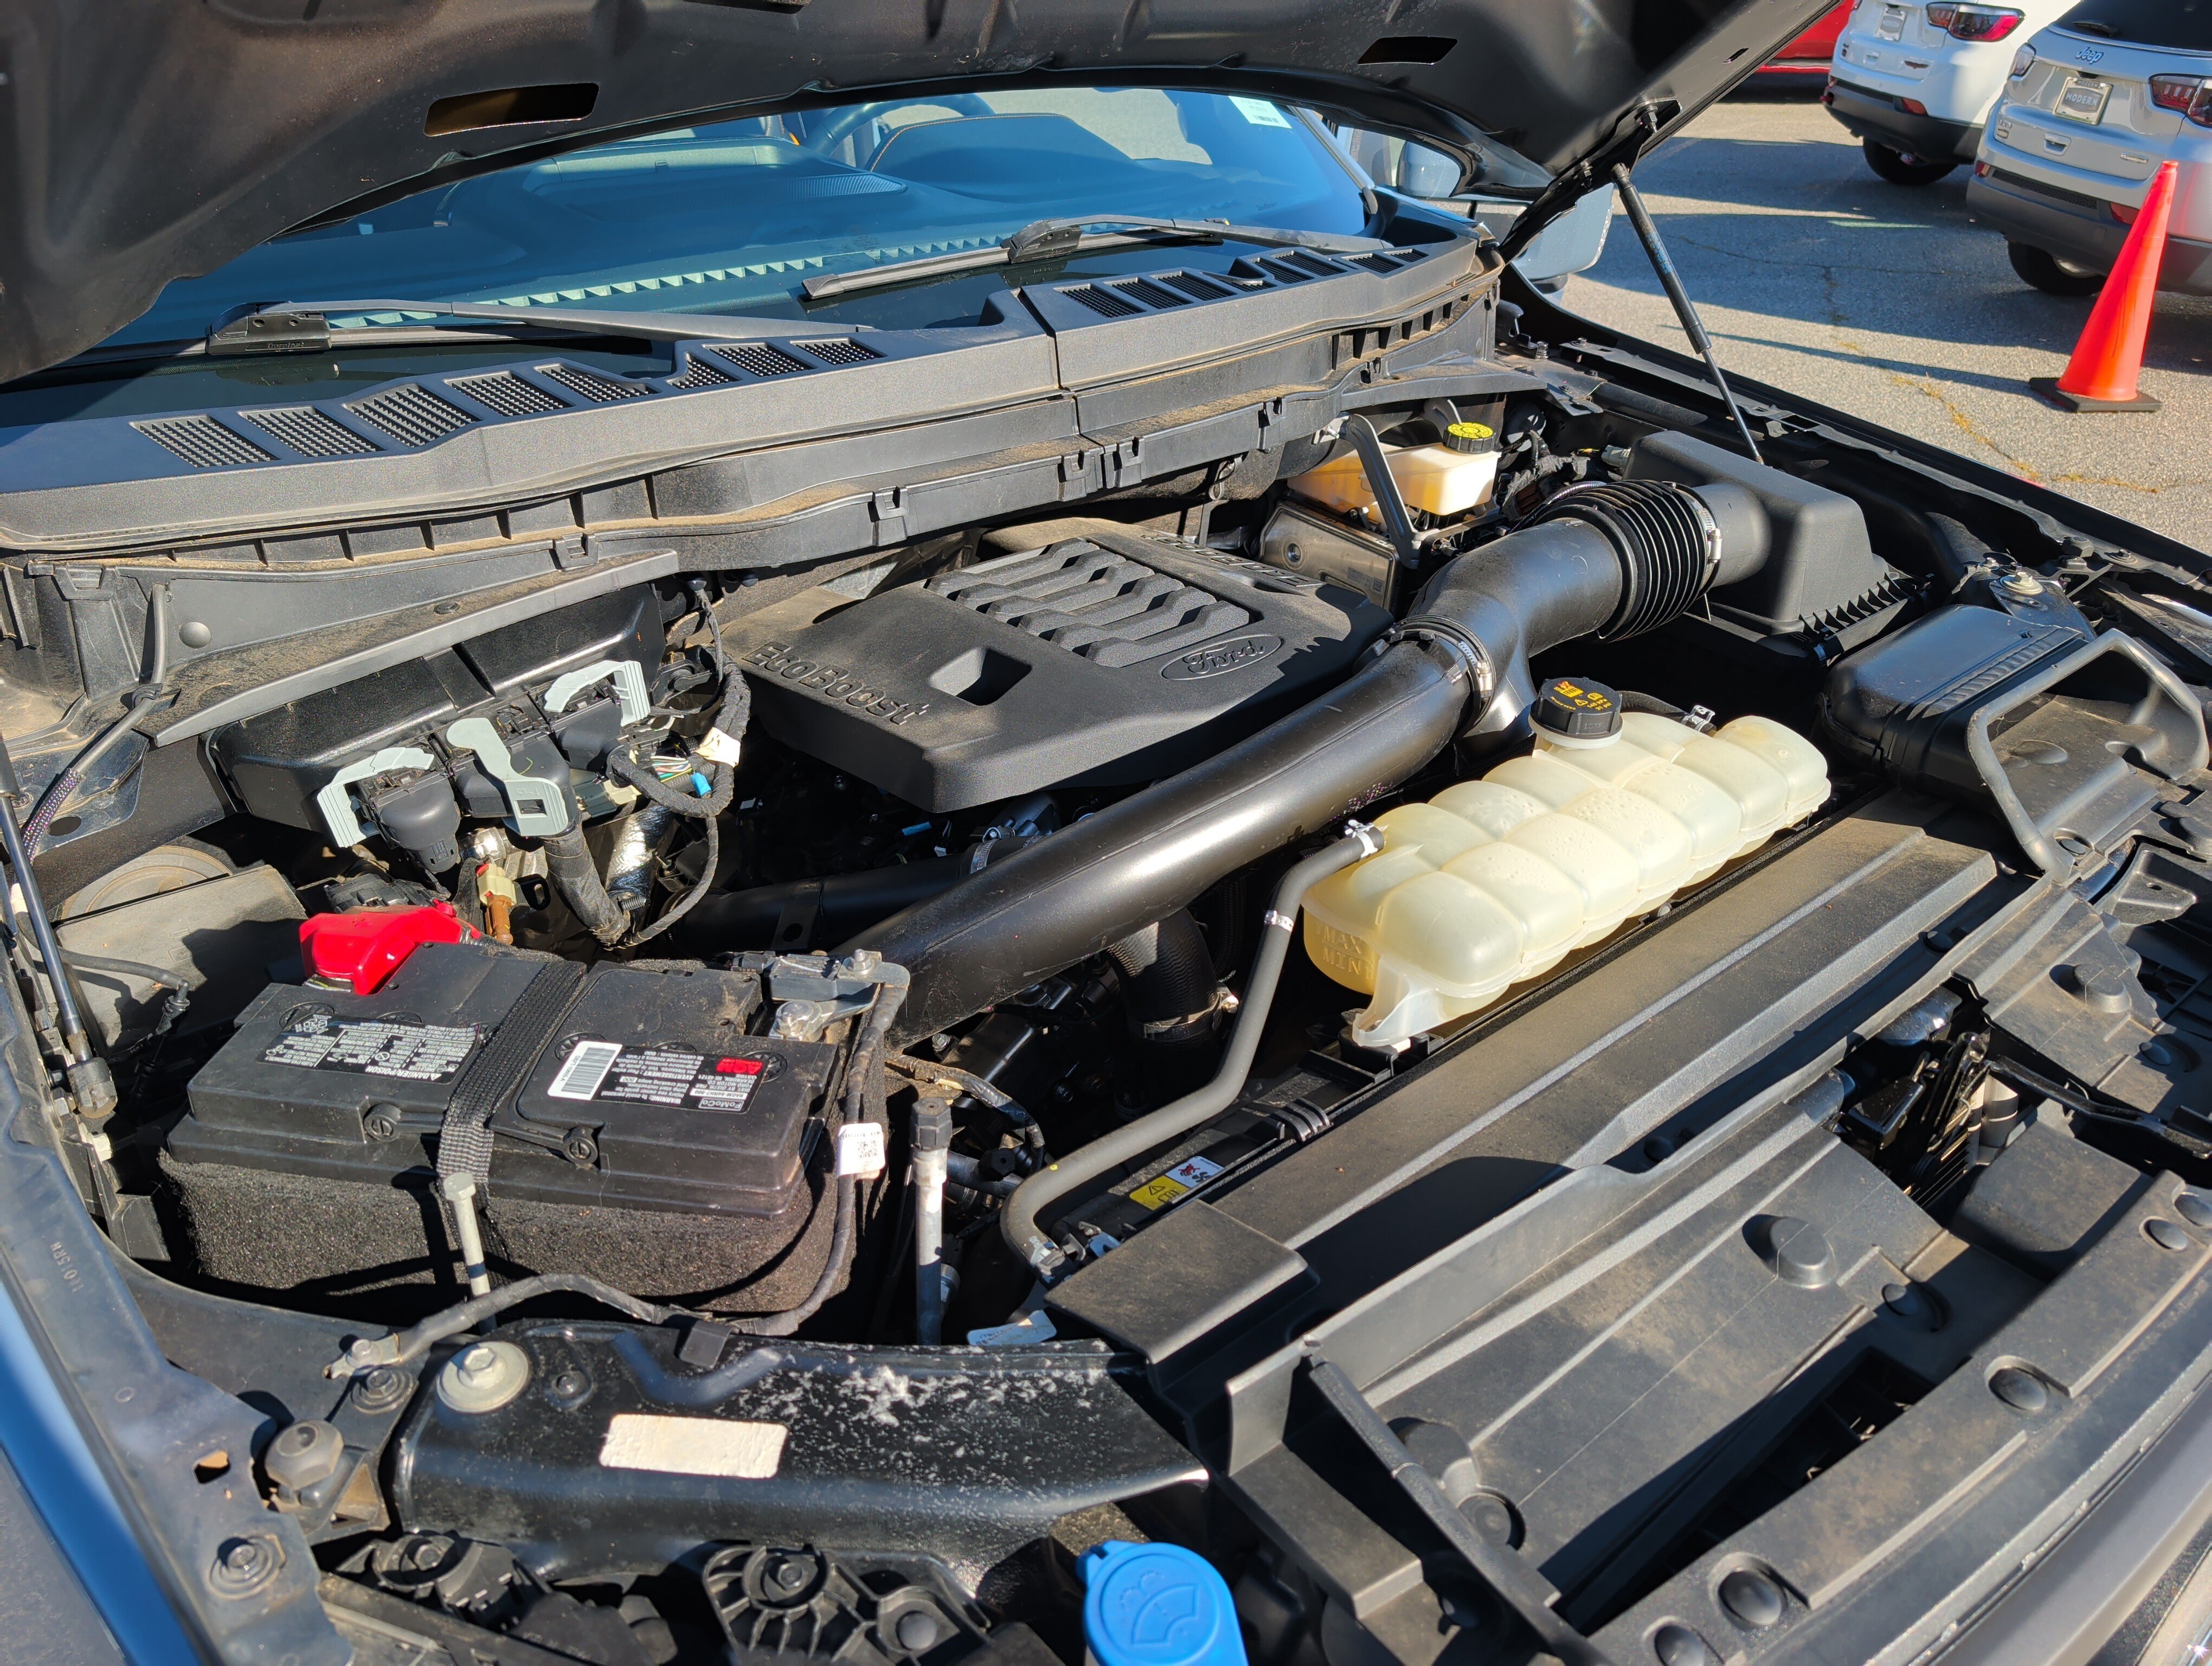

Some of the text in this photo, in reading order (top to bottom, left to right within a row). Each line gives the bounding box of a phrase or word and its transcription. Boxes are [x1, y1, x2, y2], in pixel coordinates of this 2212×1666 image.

[2075, 47, 2104, 65] Jeep
[2066, 92, 2099, 106] MODERN
[1185, 639, 1266, 676] Ford
[743, 641, 928, 726] EcoBoost
[1323, 926, 1362, 954] MAX
[1322, 948, 1362, 975] MIN
[362, 1065, 430, 1079] DANGER/POISON
[715, 1061, 761, 1075] AGM
[647, 1094, 683, 1104] WARNING:
[701, 1099, 741, 1109] FoMoCo
